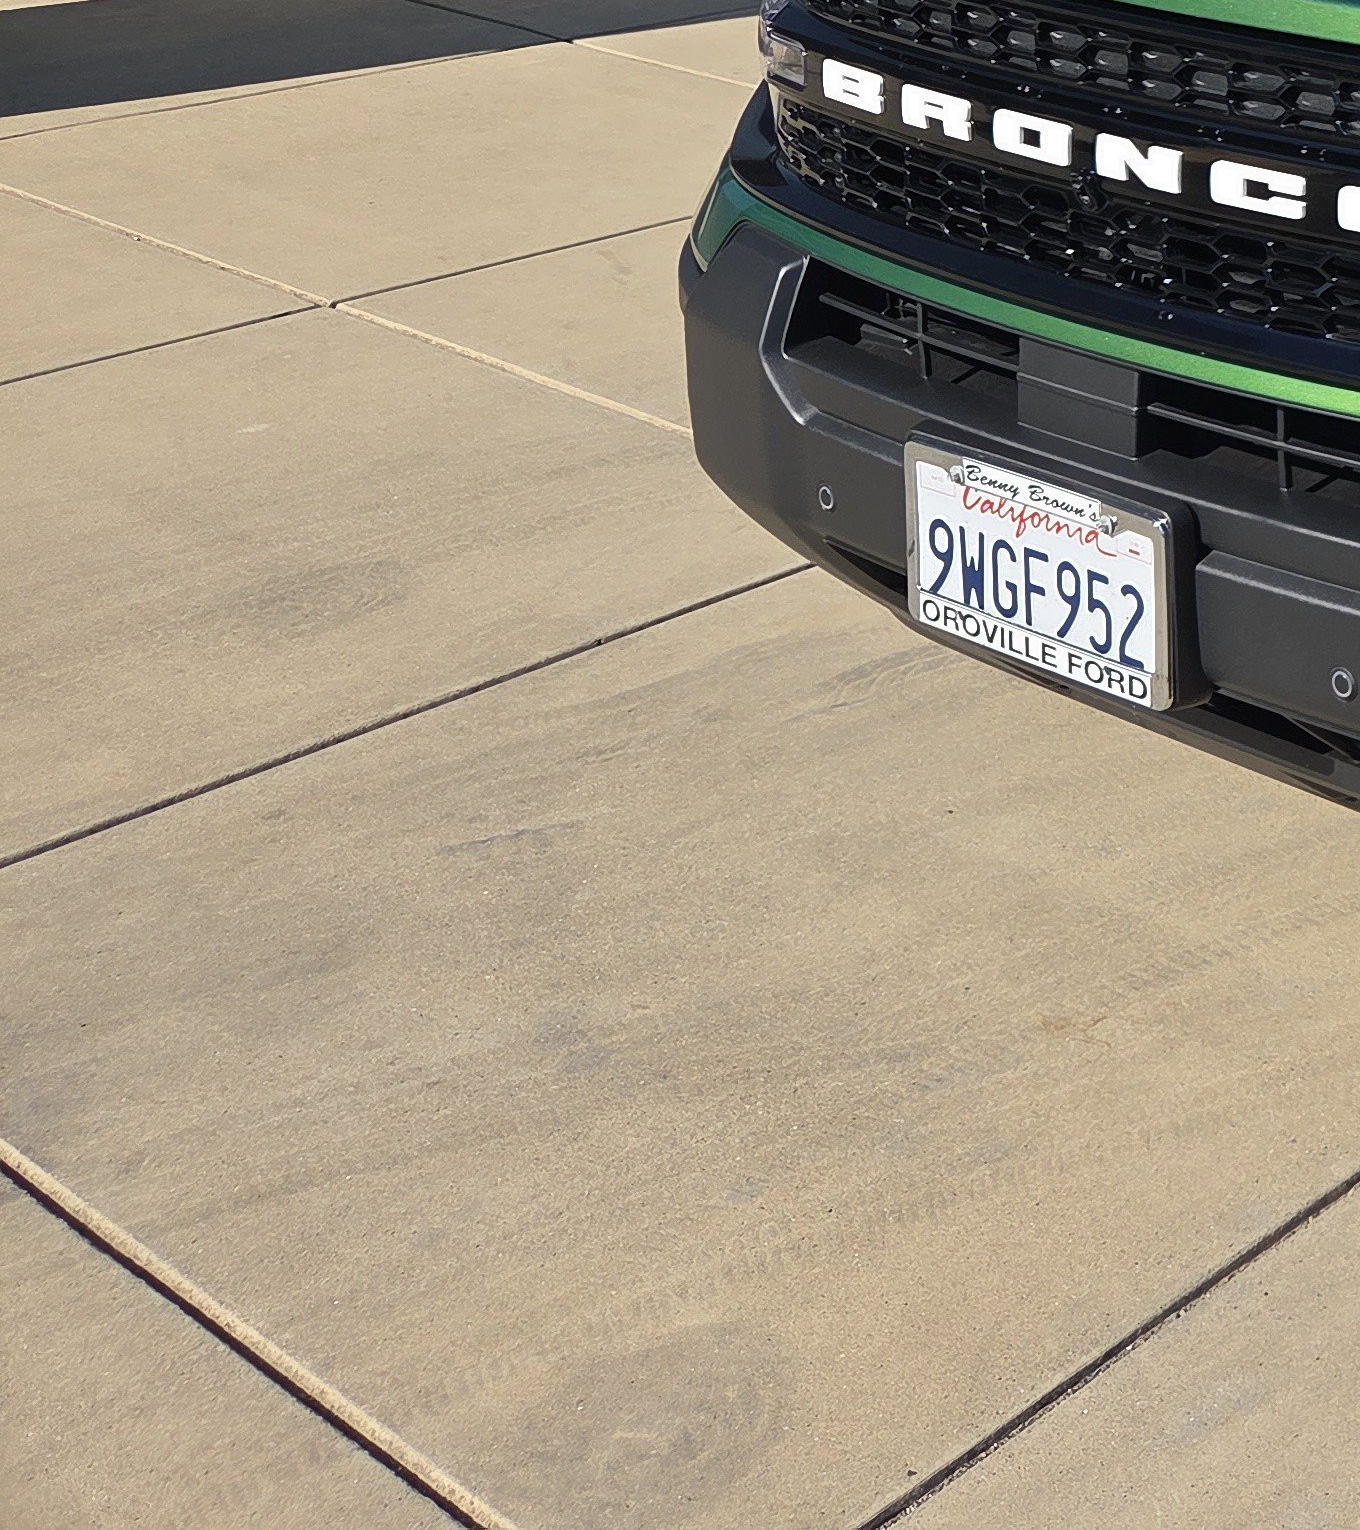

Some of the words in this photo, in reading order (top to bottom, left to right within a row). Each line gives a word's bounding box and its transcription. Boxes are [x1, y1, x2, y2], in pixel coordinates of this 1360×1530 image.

[962, 486, 1117, 558] California
[966, 464, 1020, 498] Benny
[1028, 484, 1098, 522] Brown's
[928, 518, 1145, 671] 9WGF952
[923, 600, 1058, 669] OROVILLE
[1068, 652, 1148, 700] FORD
